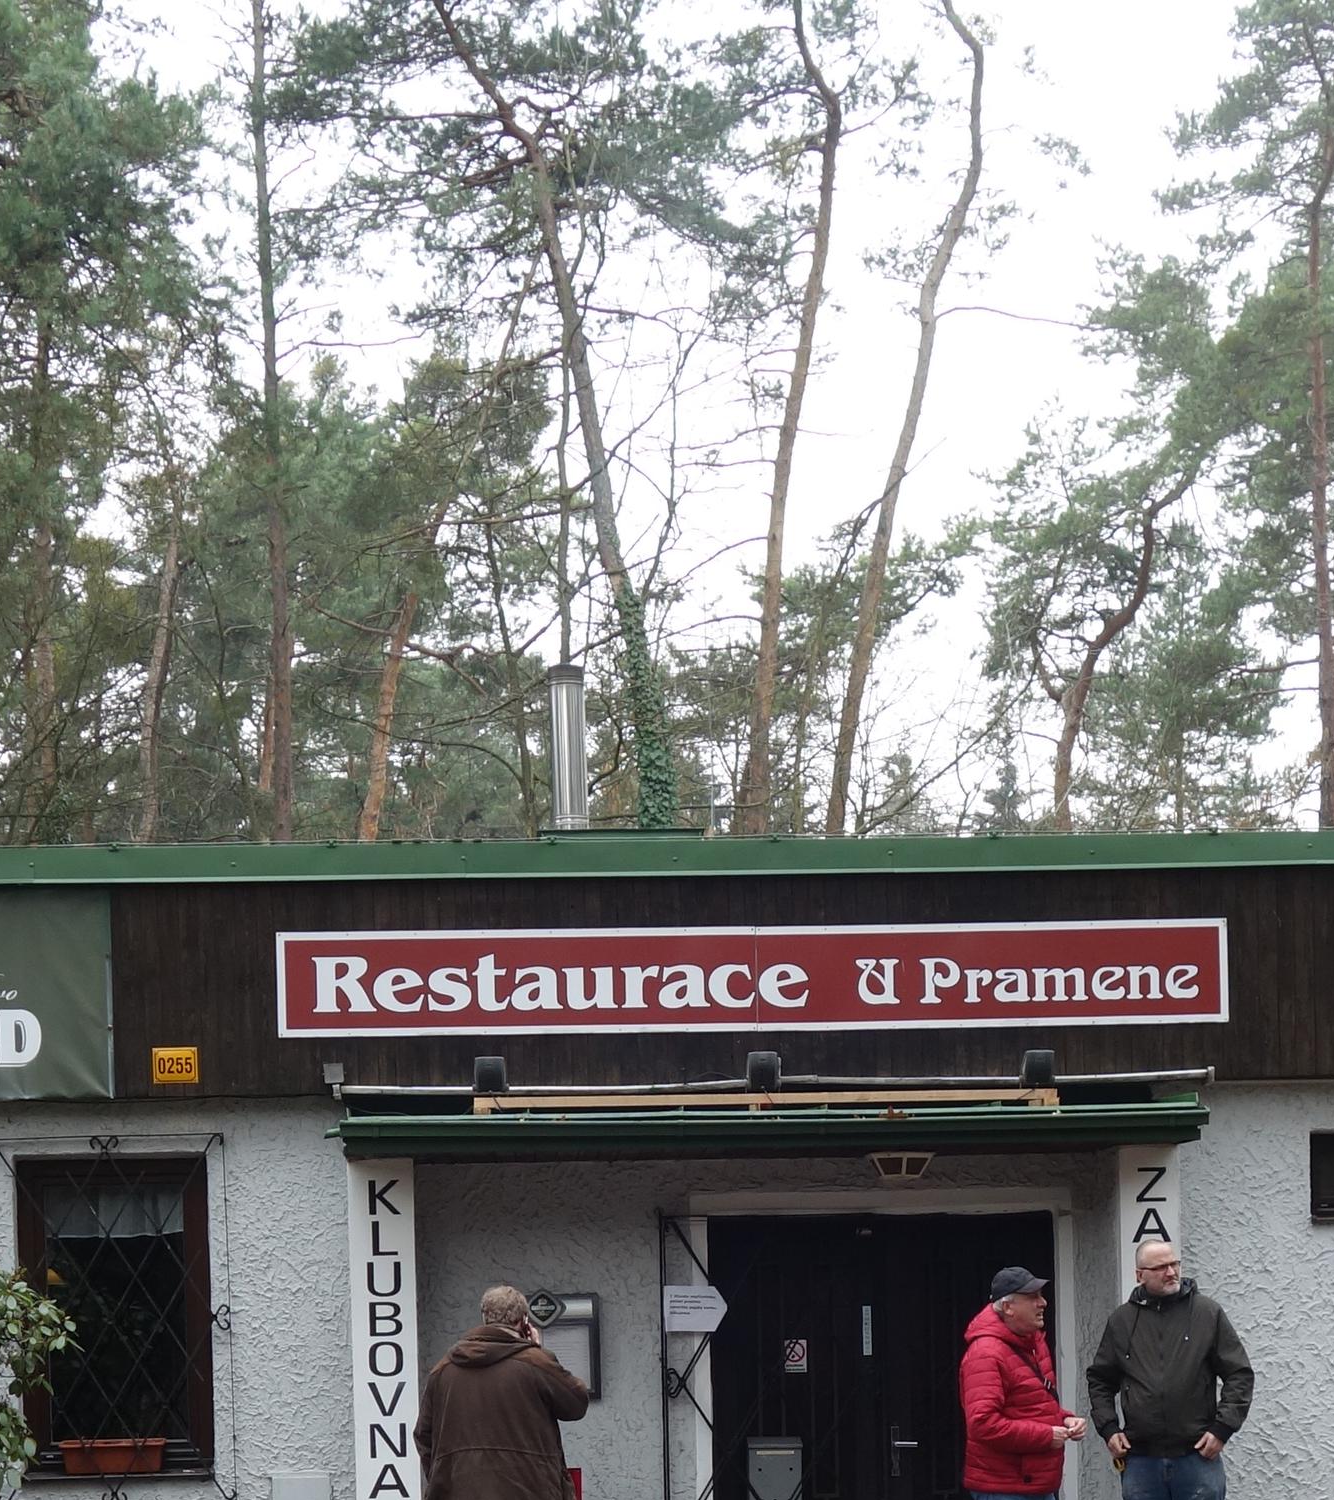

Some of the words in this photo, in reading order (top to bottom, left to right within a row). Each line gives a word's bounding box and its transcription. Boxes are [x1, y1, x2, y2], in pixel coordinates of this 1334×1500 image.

[311, 953, 810, 1014] Restaurace
[854, 957, 901, 1005] U
[918, 956, 1200, 1005] Pramene
[158, 1057, 193, 1075] 0255
[366, 1178, 411, 1500] KLUBOVNA
